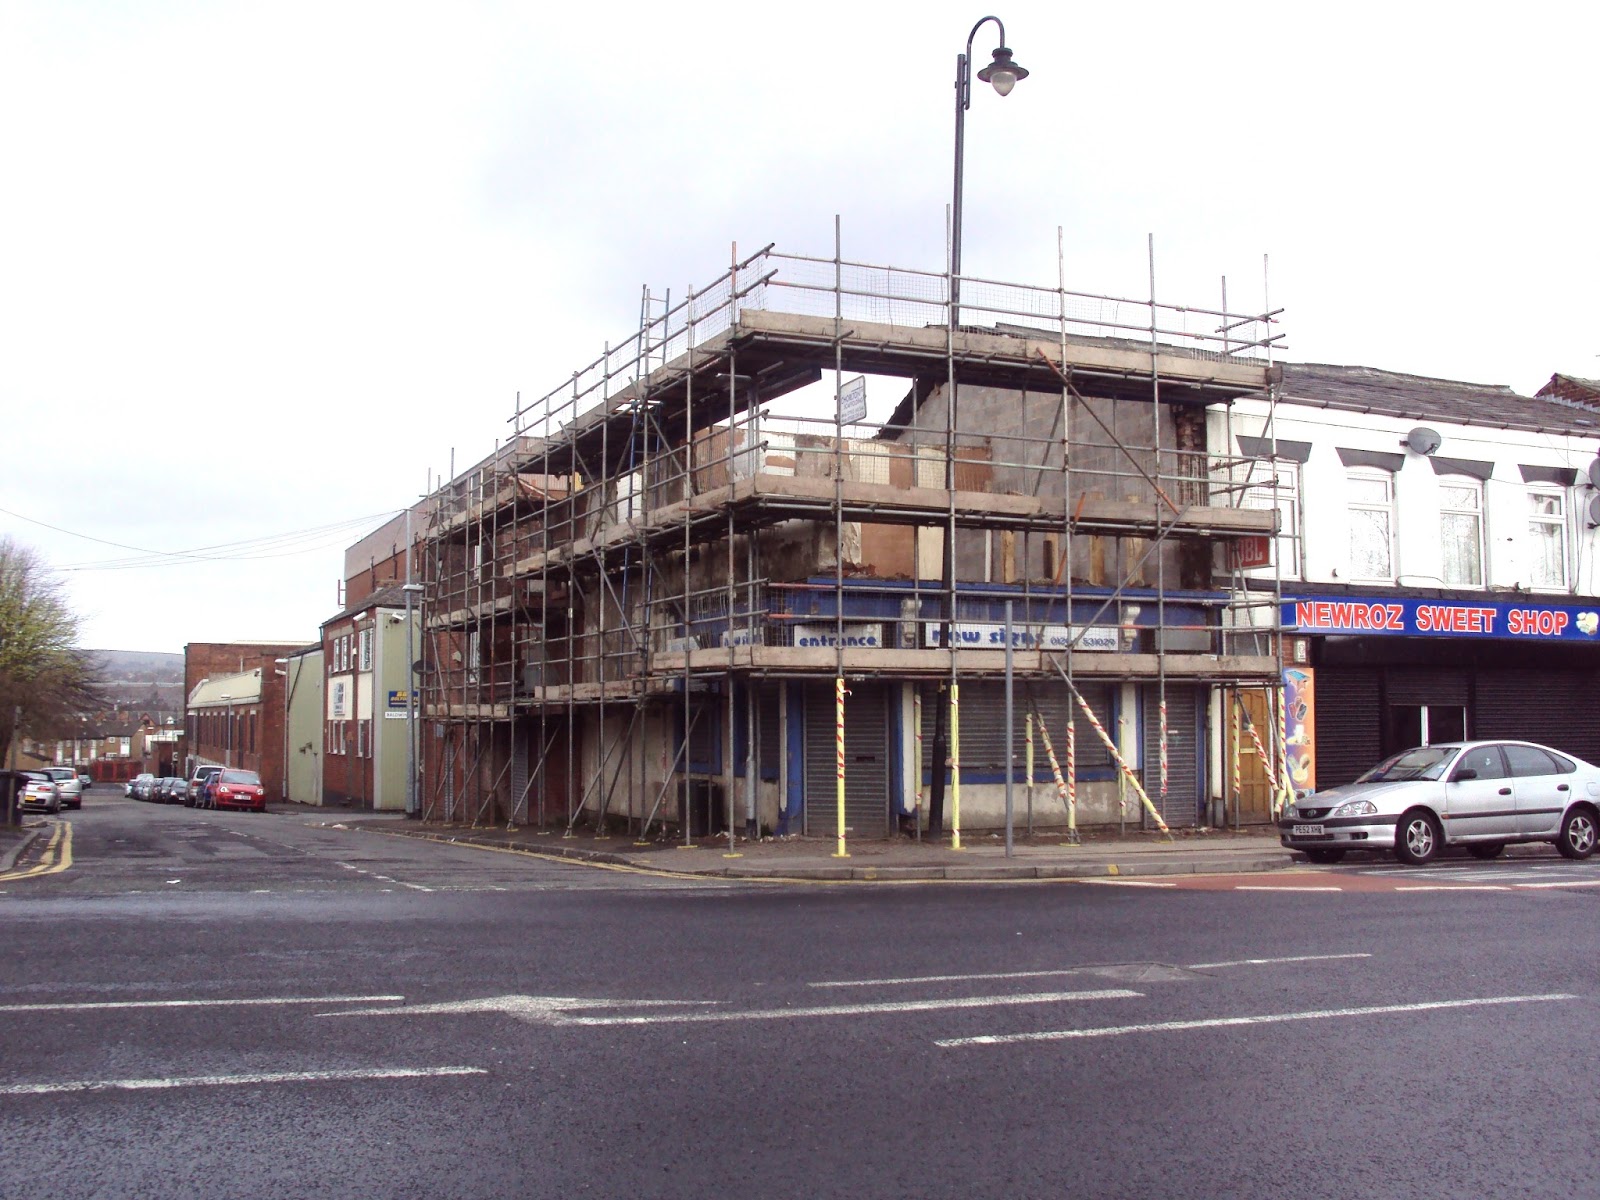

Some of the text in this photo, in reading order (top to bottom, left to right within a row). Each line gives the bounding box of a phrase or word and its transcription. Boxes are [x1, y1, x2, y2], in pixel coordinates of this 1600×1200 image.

[1295, 601, 1568, 635] NEWROZ SWEET SHOP
[799, 635, 876, 647] entrance
